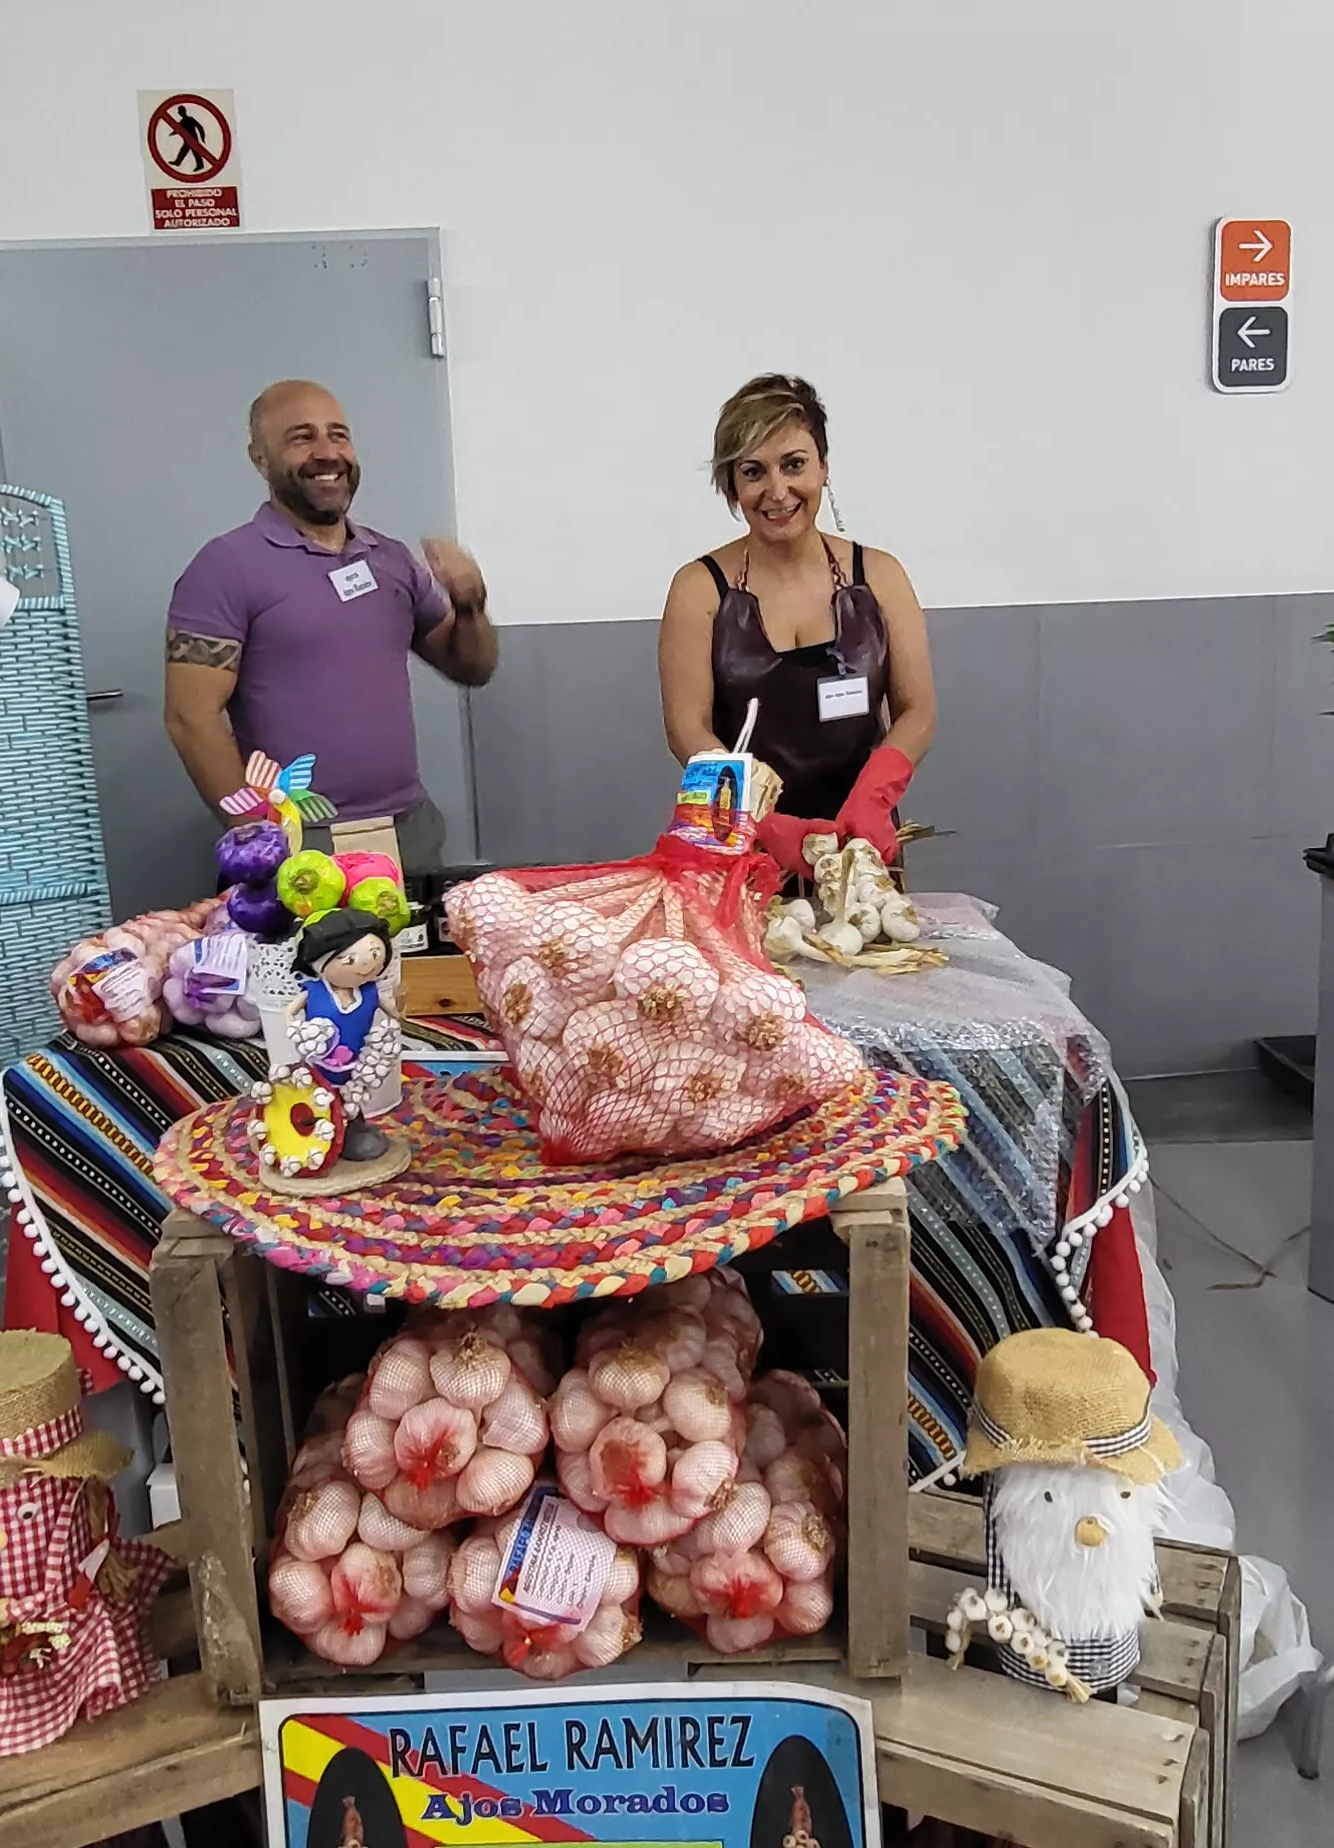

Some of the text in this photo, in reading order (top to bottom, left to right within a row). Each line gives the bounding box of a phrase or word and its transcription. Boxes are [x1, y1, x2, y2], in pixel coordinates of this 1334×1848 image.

[175, 198, 215, 208] EL PASO
[155, 208, 237, 218] SOLO PERSONAL
[164, 218, 230, 228] AUTORIZADO
[1225, 272, 1286, 286] IMPARES
[1231, 358, 1275, 372] PARES
[389, 1714, 756, 1778] RAFAEL RAMIREZ
[420, 1785, 730, 1826] Ajos Morados
